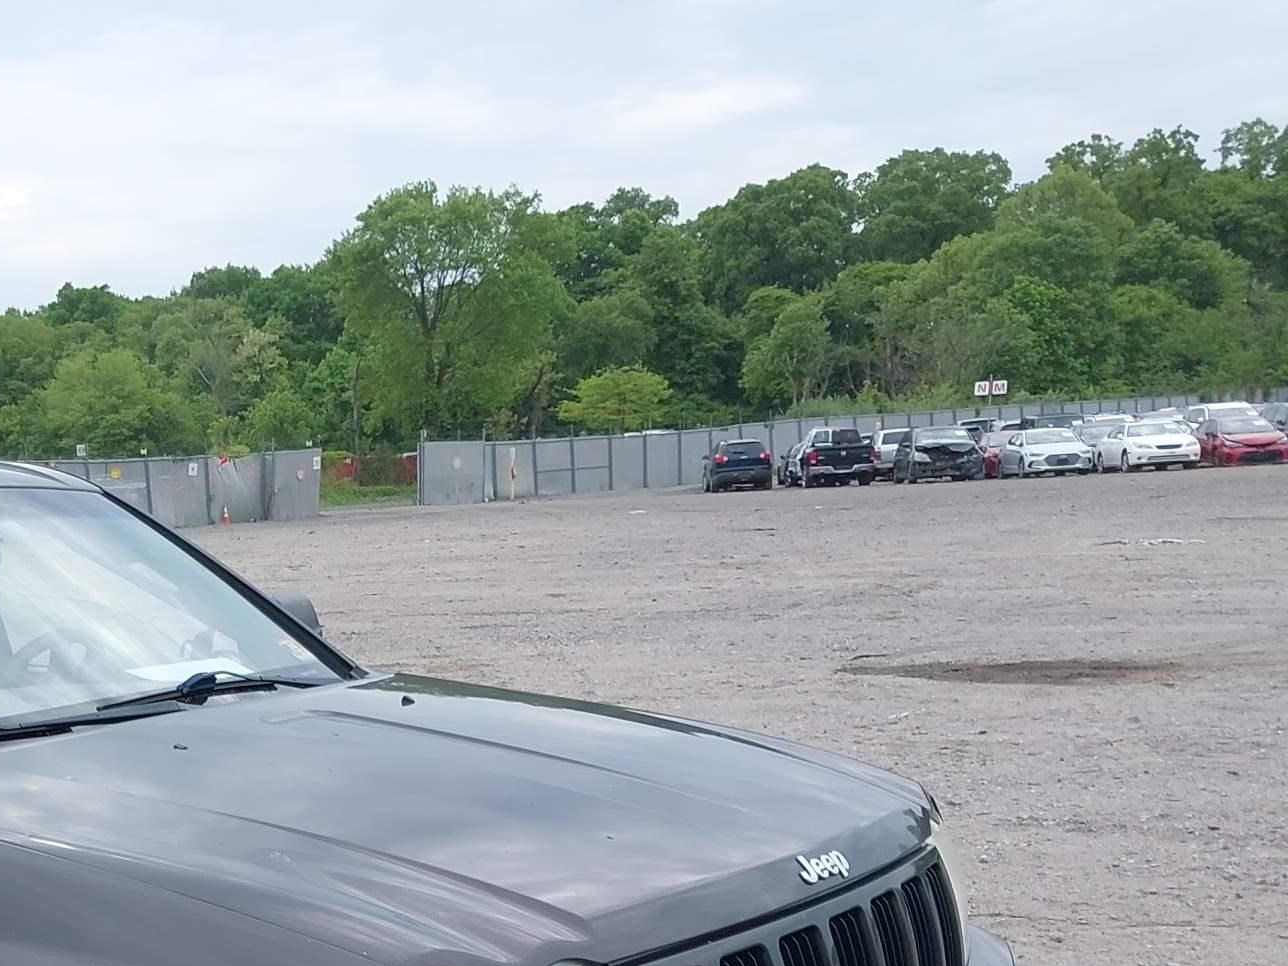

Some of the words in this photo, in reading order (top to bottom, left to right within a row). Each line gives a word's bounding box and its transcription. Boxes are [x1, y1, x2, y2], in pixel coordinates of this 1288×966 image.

[977, 383, 987, 393] N
[994, 383, 1005, 393] M
[796, 850, 850, 884] Jeep
